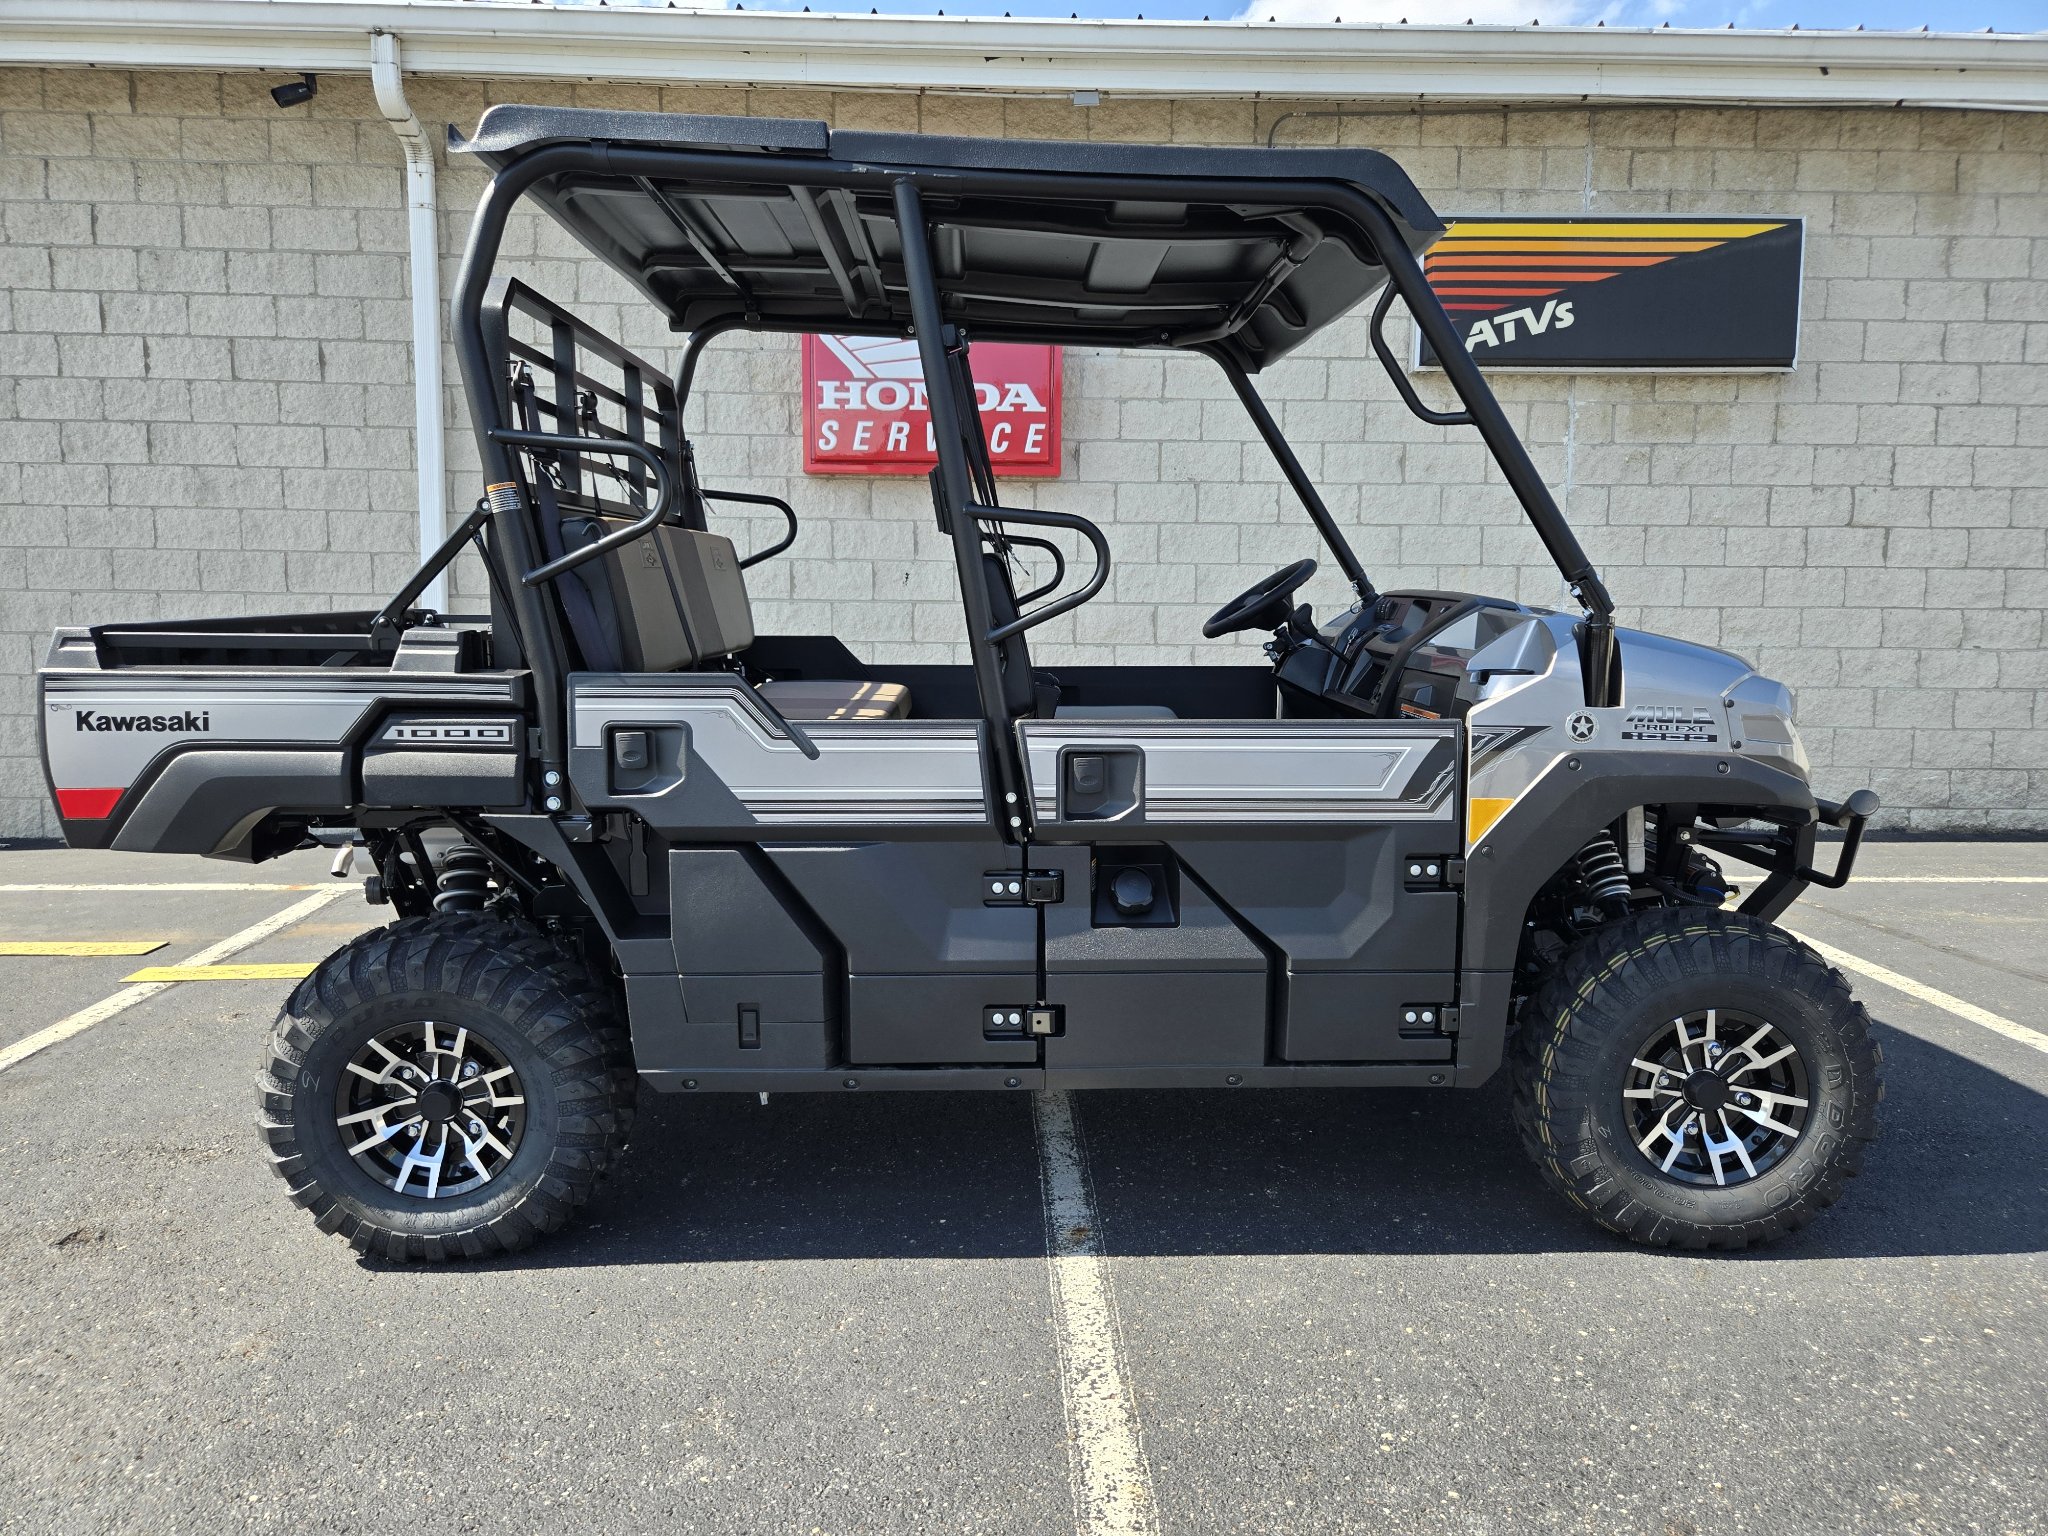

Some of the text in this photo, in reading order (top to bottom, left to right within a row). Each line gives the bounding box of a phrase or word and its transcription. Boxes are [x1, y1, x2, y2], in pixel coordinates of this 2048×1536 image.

[1464, 299, 1575, 353] ATVs
[818, 420, 1046, 454] SERCE
[76, 711, 209, 732] Kawasaki
[1626, 705, 1715, 724] MULE
[395, 729, 504, 738] 1000
